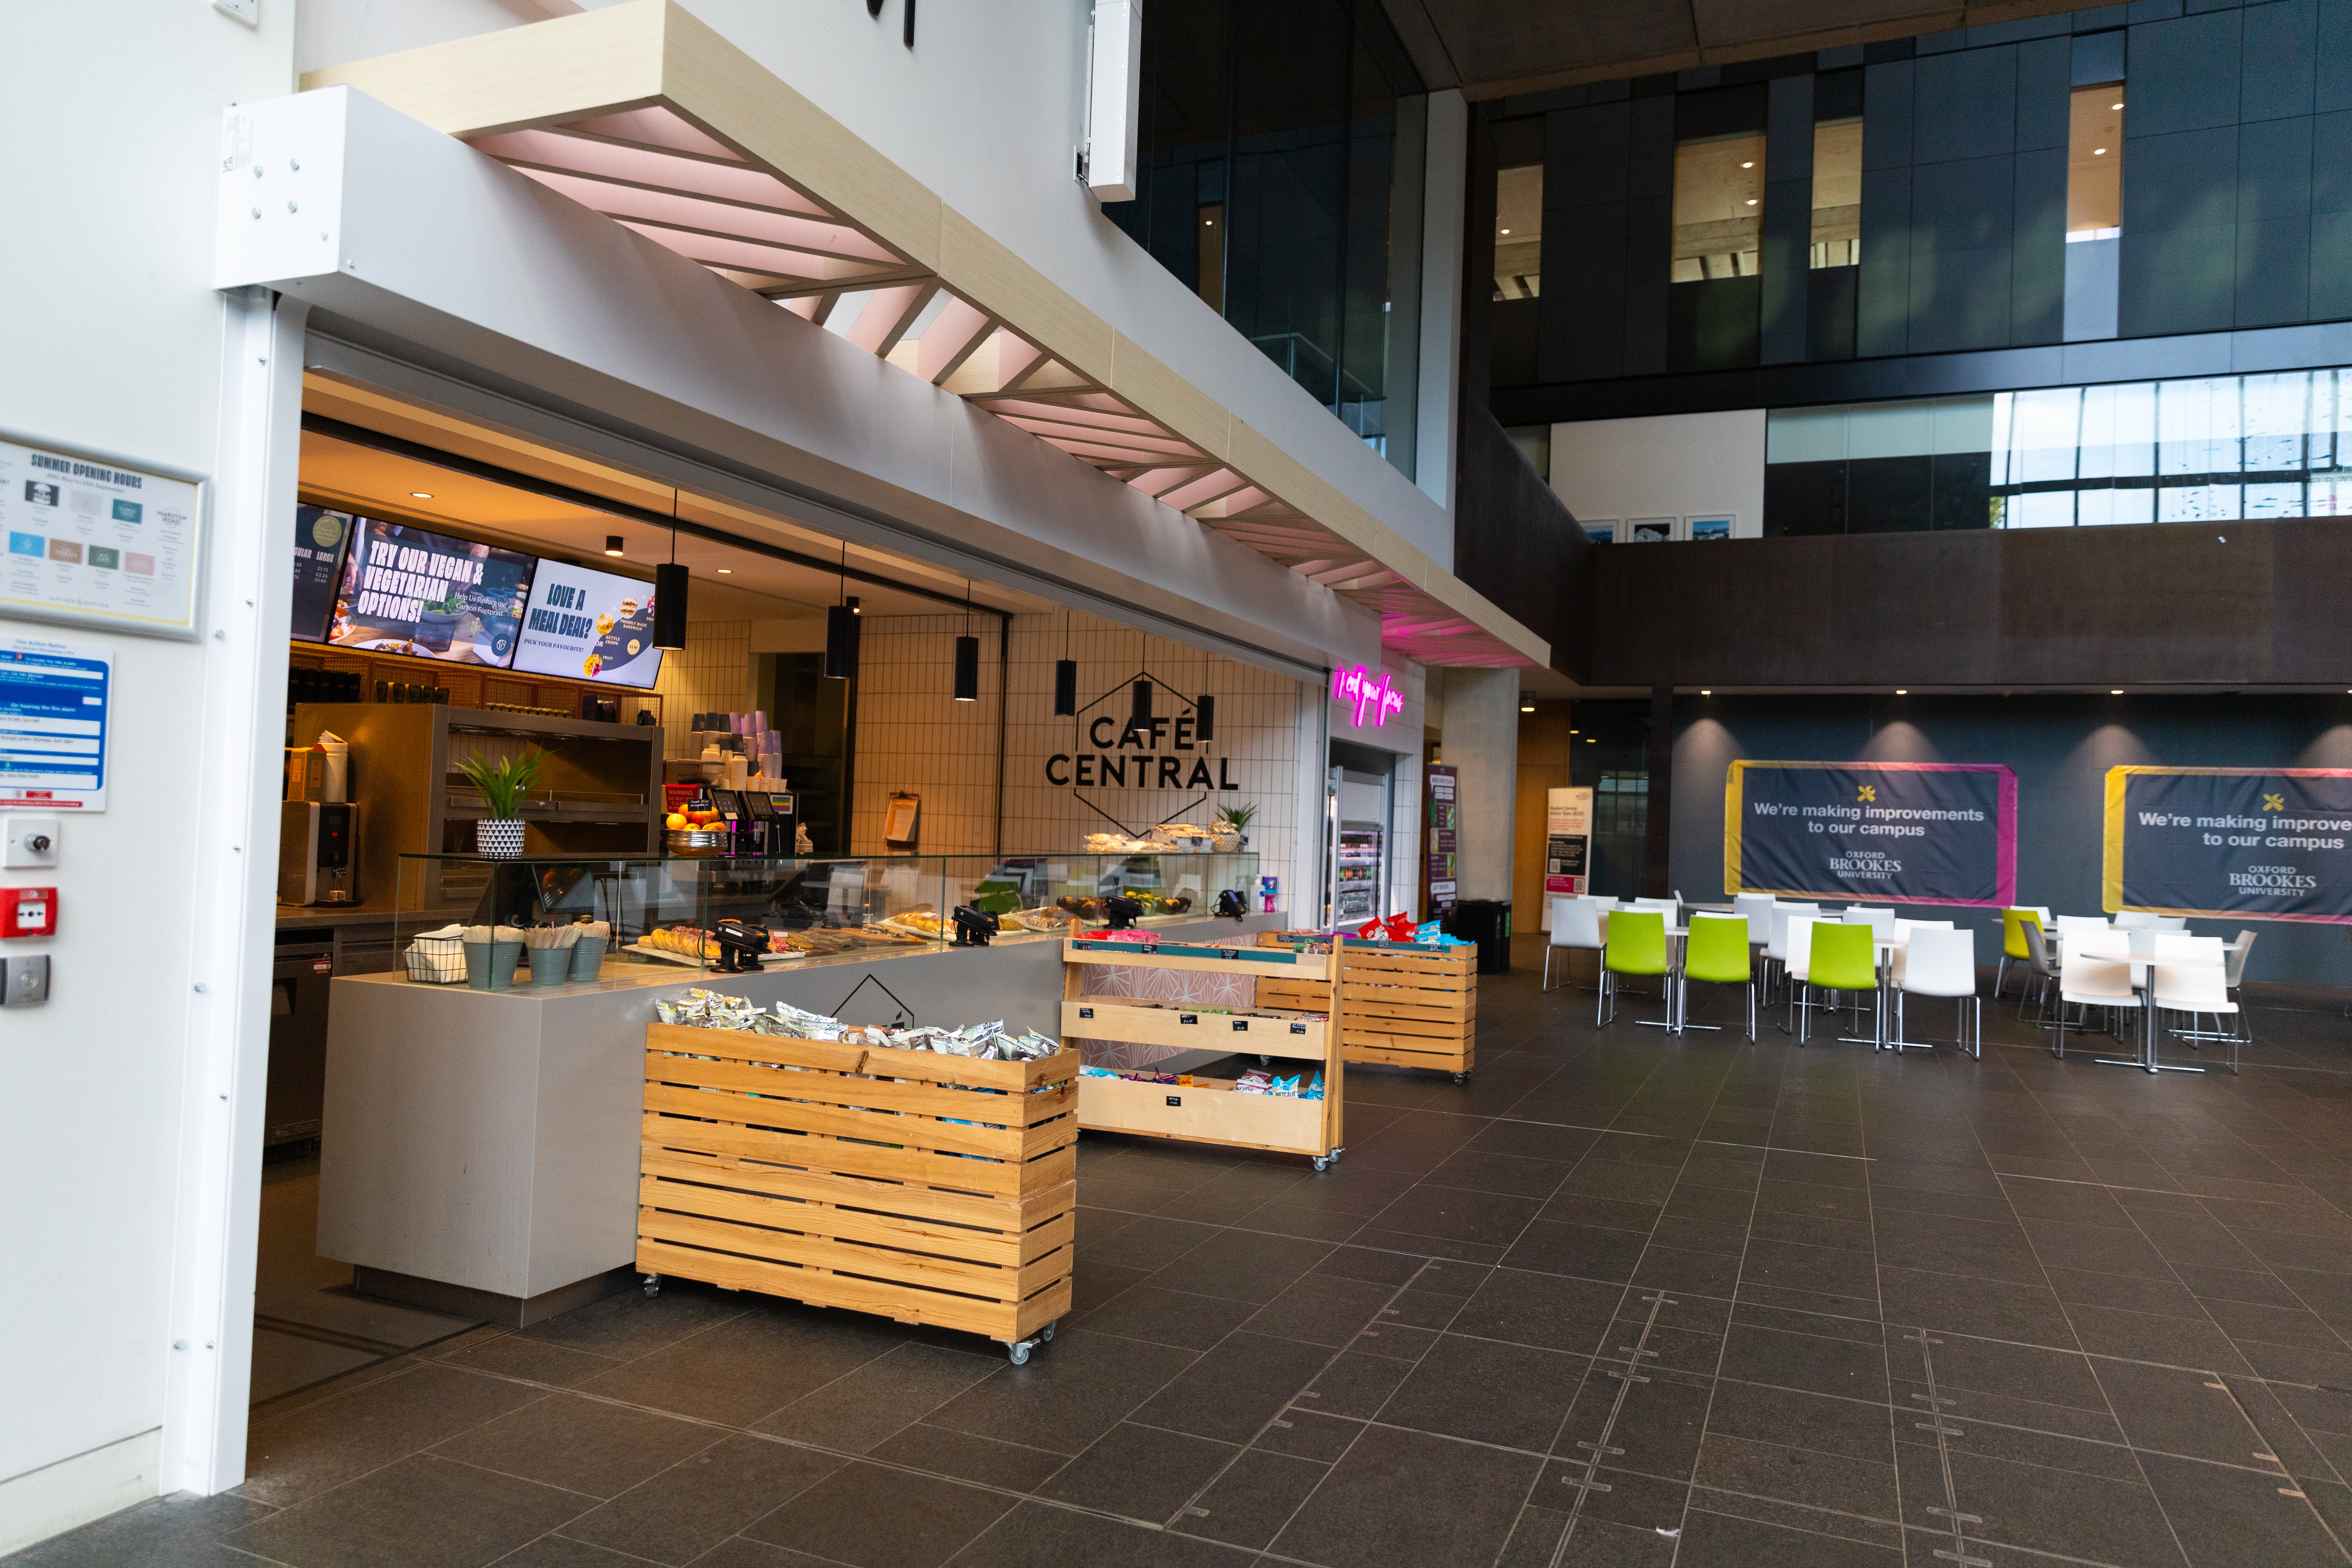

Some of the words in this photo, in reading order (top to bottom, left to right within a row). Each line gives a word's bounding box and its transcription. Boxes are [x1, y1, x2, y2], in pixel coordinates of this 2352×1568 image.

[32, 454, 71, 474] SUMMER
[74, 463, 112, 482] OPENING
[114, 472, 142, 489] HOURS
[95, 483, 126, 493] September
[158, 511, 187, 521] MARSTON
[316, 551, 334, 563] LARGE
[369, 541, 398, 569] TRY
[398, 547, 428, 575] OUR
[429, 553, 474, 583] VEGAN
[473, 563, 484, 586] &
[363, 565, 449, 603] VEGETARIAN
[454, 592, 468, 601] Help
[477, 596, 498, 606] Reduce
[547, 583, 576, 609] LOVE
[575, 589, 586, 611] A
[358, 591, 424, 623] OPTIONS!
[456, 603, 476, 612] Carbon
[477, 606, 503, 617] Footprint
[528, 608, 560, 634] MEAL
[558, 614, 593, 639] DEAL?
[553, 643, 584, 652] FAVOURITE!
[1090, 707, 1195, 750] CAFÉ
[1046, 754, 1239, 790] CENTRAL
[1755, 802, 1798, 815] We're
[1802, 805, 1861, 820] making
[1865, 806, 1984, 822] improvements
[2139, 812, 2191, 827] We're
[2196, 815, 2266, 831] making
[1808, 822, 1824, 833] to
[1828, 824, 1853, 834] our
[1859, 825, 1925, 838] campus
[2202, 833, 2221, 845] to
[2228, 835, 2260, 847] our
[2265, 836, 2344, 851] campus
[1845, 851, 1885, 859] OXFORD
[1829, 857, 1902, 872] BROOKES
[2248, 865, 2296, 874] OXFORD
[1837, 870, 1893, 880] UNIVERSITY
[2229, 873, 2317, 888] BROOKES
[2239, 887, 2306, 896] UNIVERSITY
